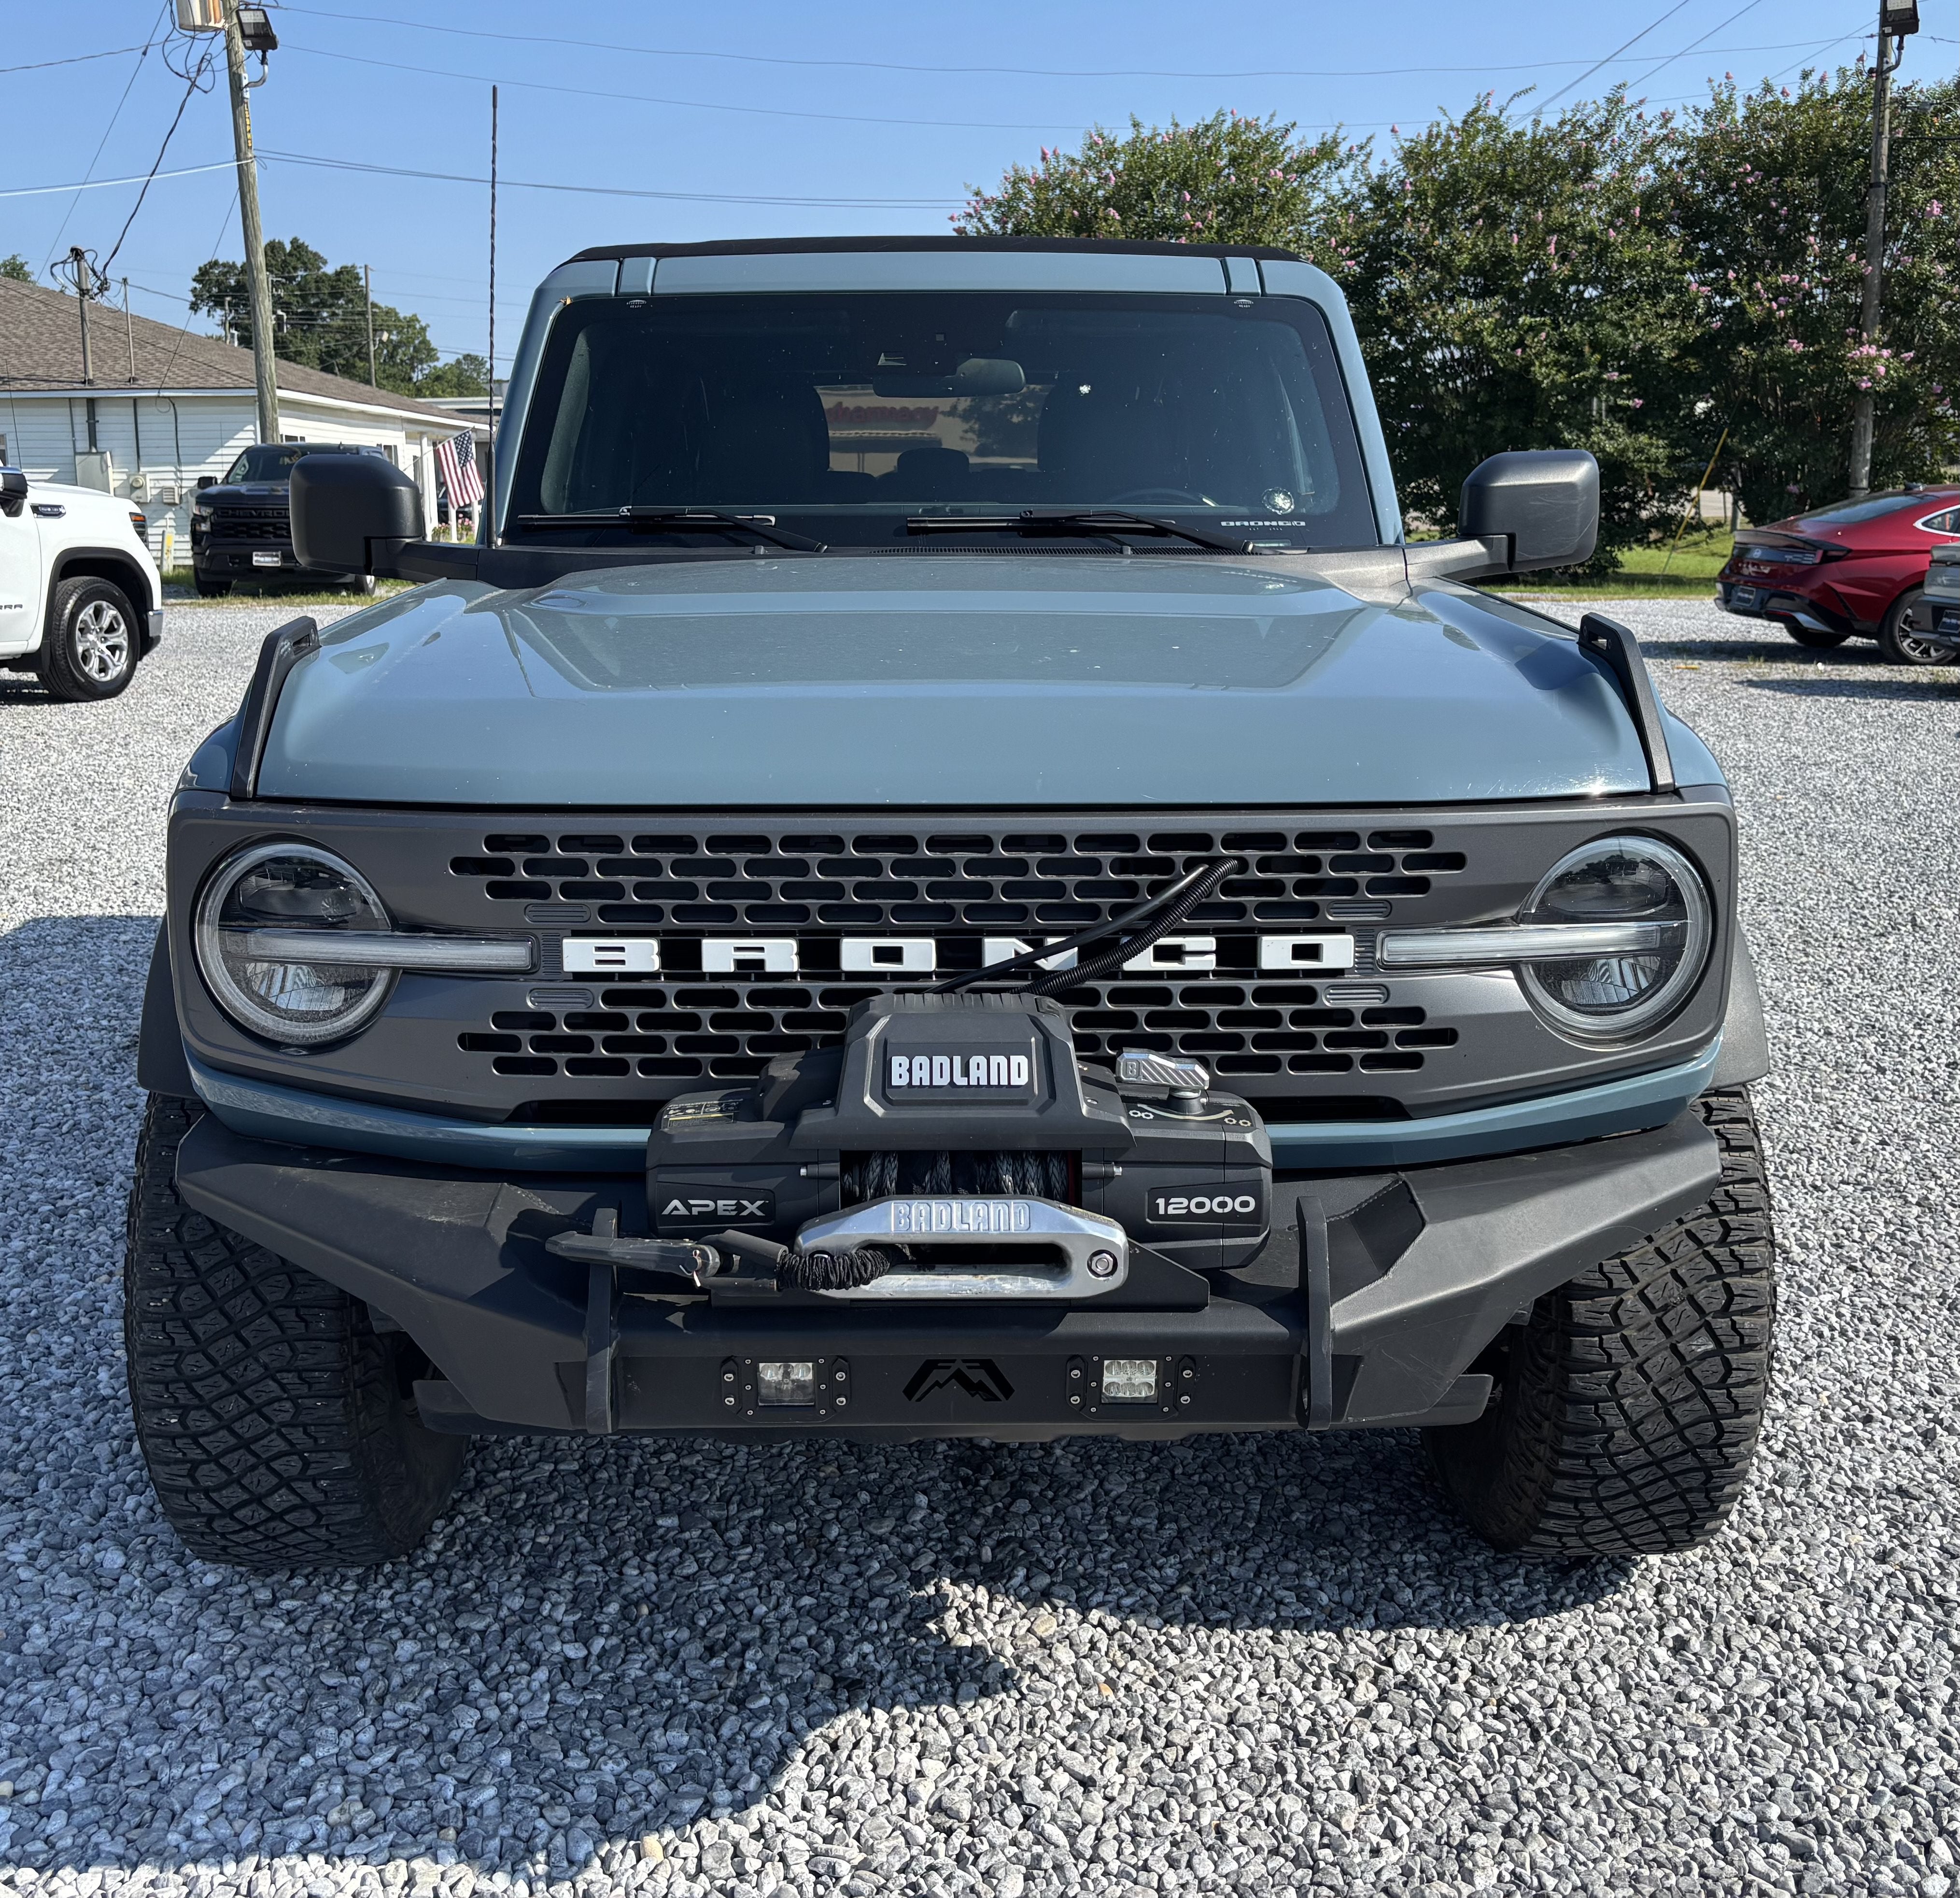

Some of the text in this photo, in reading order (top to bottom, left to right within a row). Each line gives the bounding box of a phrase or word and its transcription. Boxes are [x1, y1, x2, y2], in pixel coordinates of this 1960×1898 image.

[563, 935, 1354, 972] BRONCO
[891, 1055, 1029, 1086] BADLAND
[662, 1199, 766, 1216] APEX
[891, 1201, 1031, 1232] BADLAND
[1155, 1195, 1255, 1214] 12000
